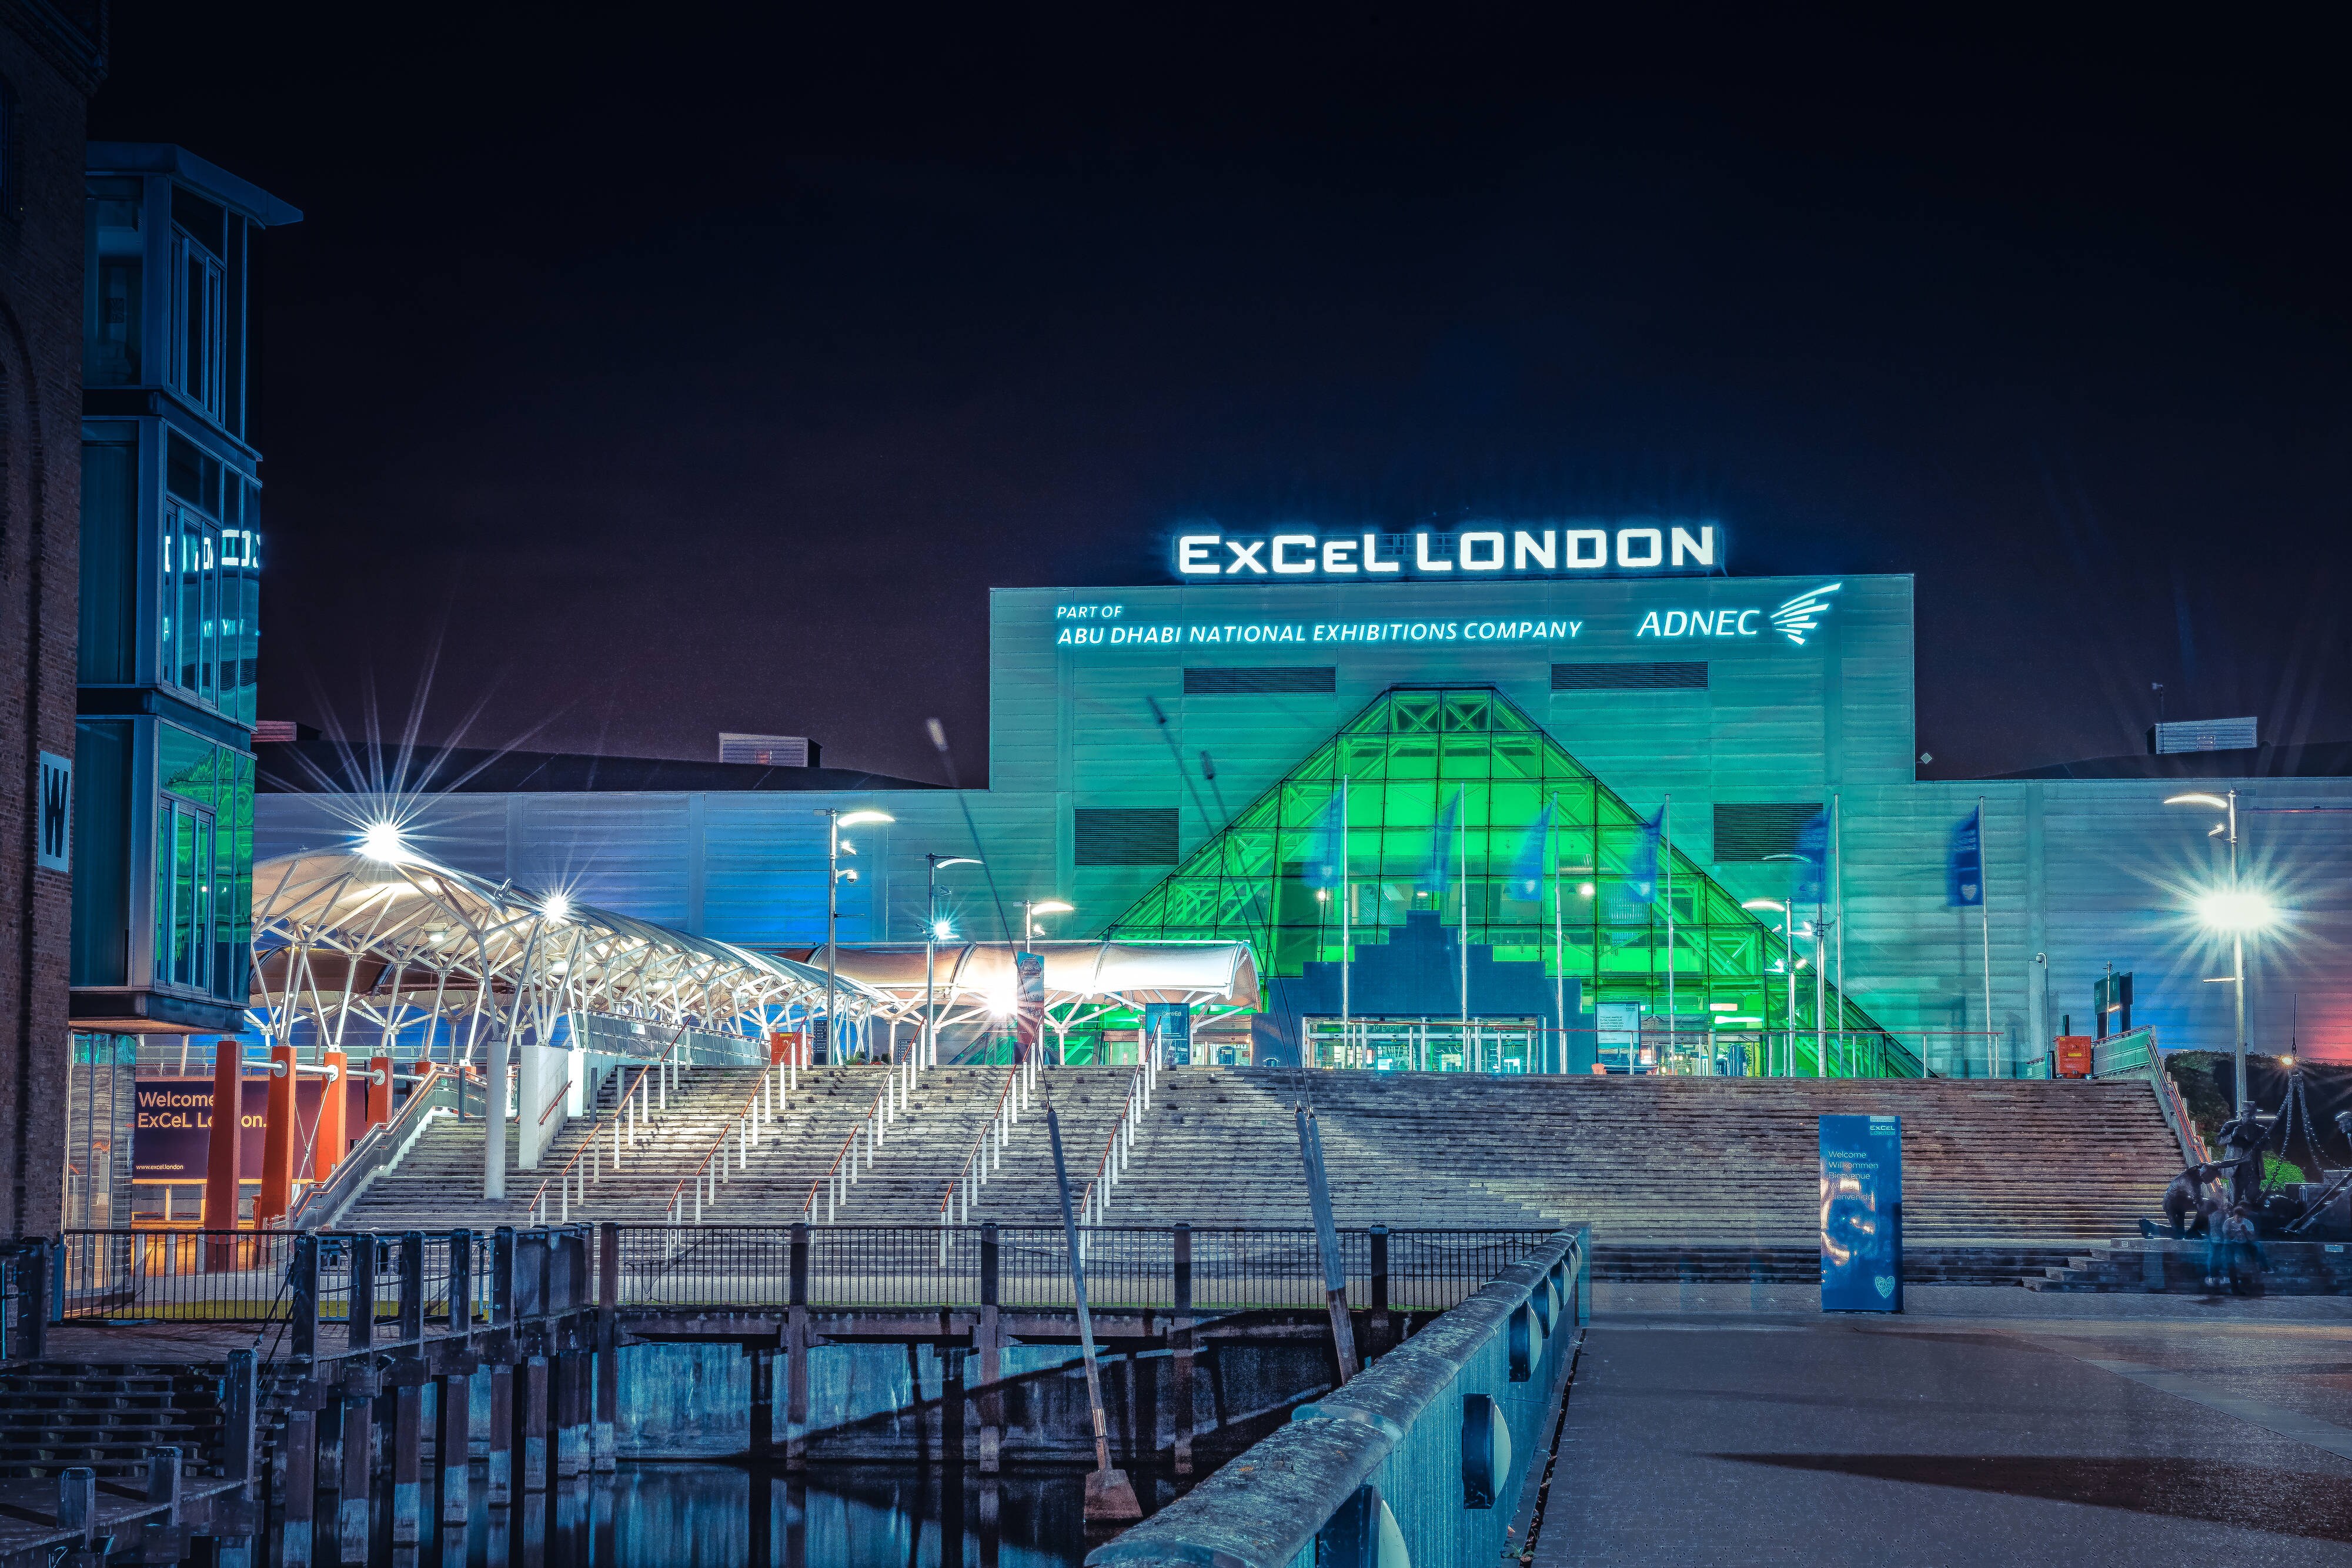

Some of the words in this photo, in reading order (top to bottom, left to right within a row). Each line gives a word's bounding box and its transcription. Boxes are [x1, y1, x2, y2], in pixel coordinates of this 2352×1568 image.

[1179, 534, 1399, 574] ExCeL
[1416, 527, 1713, 571] LONDON
[1057, 606, 1098, 618] PART
[1101, 606, 1122, 618] OF
[1636, 610, 1760, 637] ADNEC
[1057, 627, 1104, 644] ABU
[1110, 626, 1181, 644] DHABI
[1189, 624, 1307, 643] NATIONAL
[1312, 622, 1458, 641] EXHIBITIONS
[1464, 621, 1583, 640] COMPANY
[44, 763, 69, 858] W
[138, 1112, 192, 1128] ExCeL
